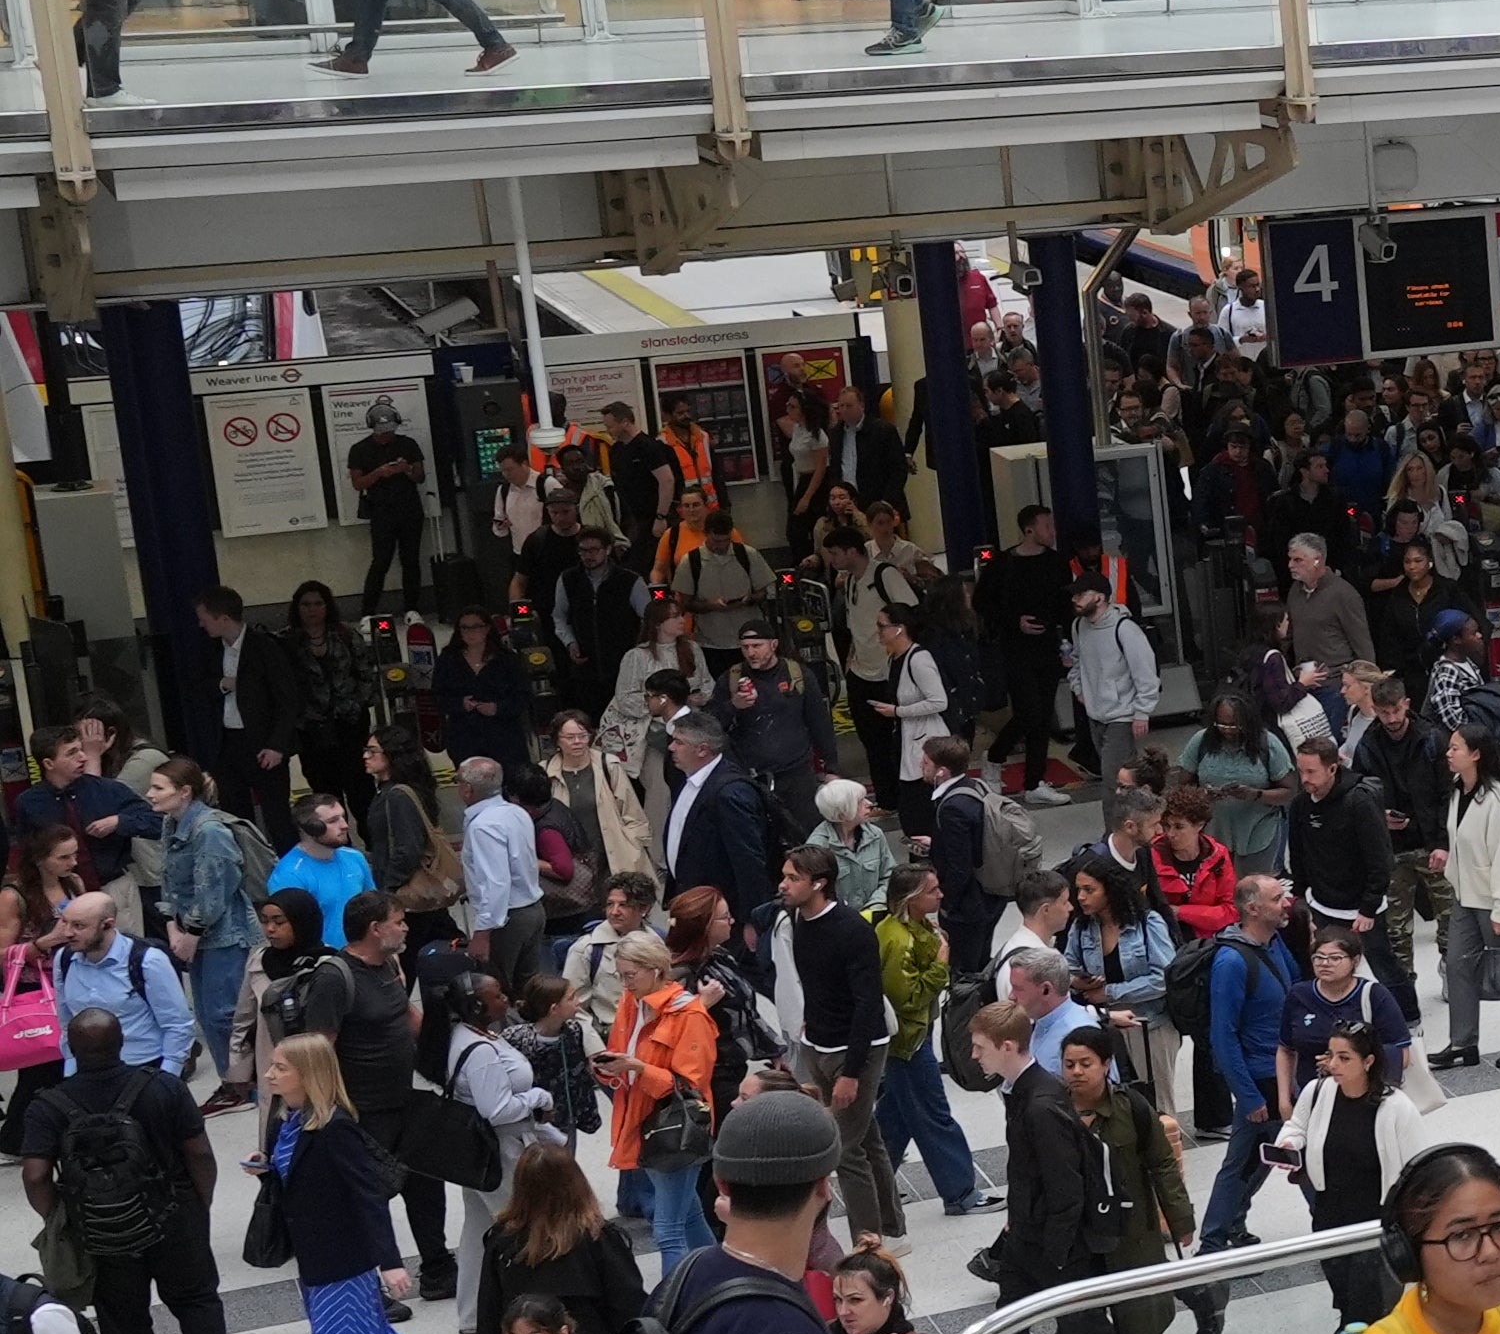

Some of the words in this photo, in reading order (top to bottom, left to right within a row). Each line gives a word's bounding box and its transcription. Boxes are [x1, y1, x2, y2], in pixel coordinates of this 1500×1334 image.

[1293, 244, 1340, 303] 4
[641, 330, 749, 349] stanstedexpress
[206, 375, 251, 387] Weaver
[254, 373, 278, 383] line
[579, 374, 596, 386] get
[599, 372, 624, 382] stuck
[332, 400, 372, 409] Weaver
